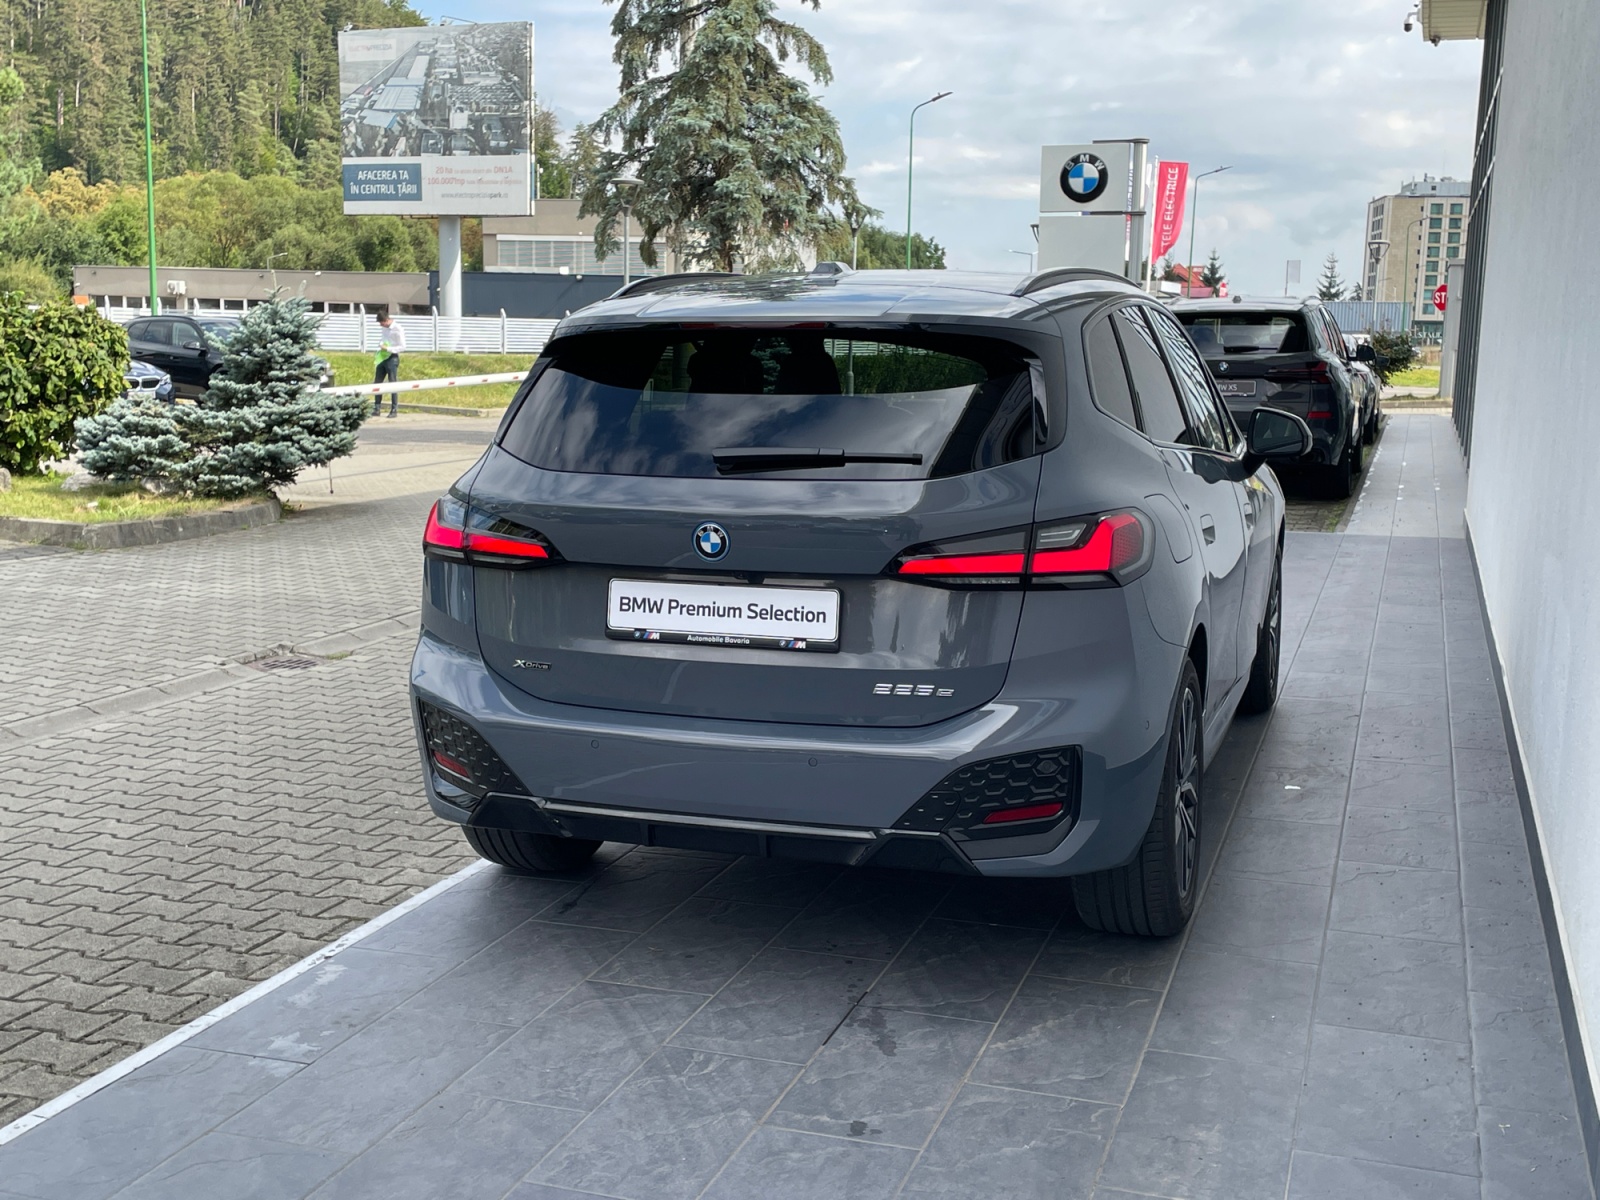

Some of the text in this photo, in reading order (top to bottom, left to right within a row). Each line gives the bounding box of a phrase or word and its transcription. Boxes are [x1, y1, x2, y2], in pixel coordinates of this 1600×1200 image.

[1064, 154, 1105, 171] BMW
[357, 170, 409, 181] AFACEREA TA
[349, 181, 359, 194] ÎN
[360, 184, 396, 195] CENTRUL
[1164, 167, 1179, 221] ELECTRICE
[1434, 291, 1447, 304] ST
[618, 596, 827, 623] BMW Premium Selection
[687, 635, 750, 645] Automobile Bavaria
[872, 683, 955, 697] 225e
